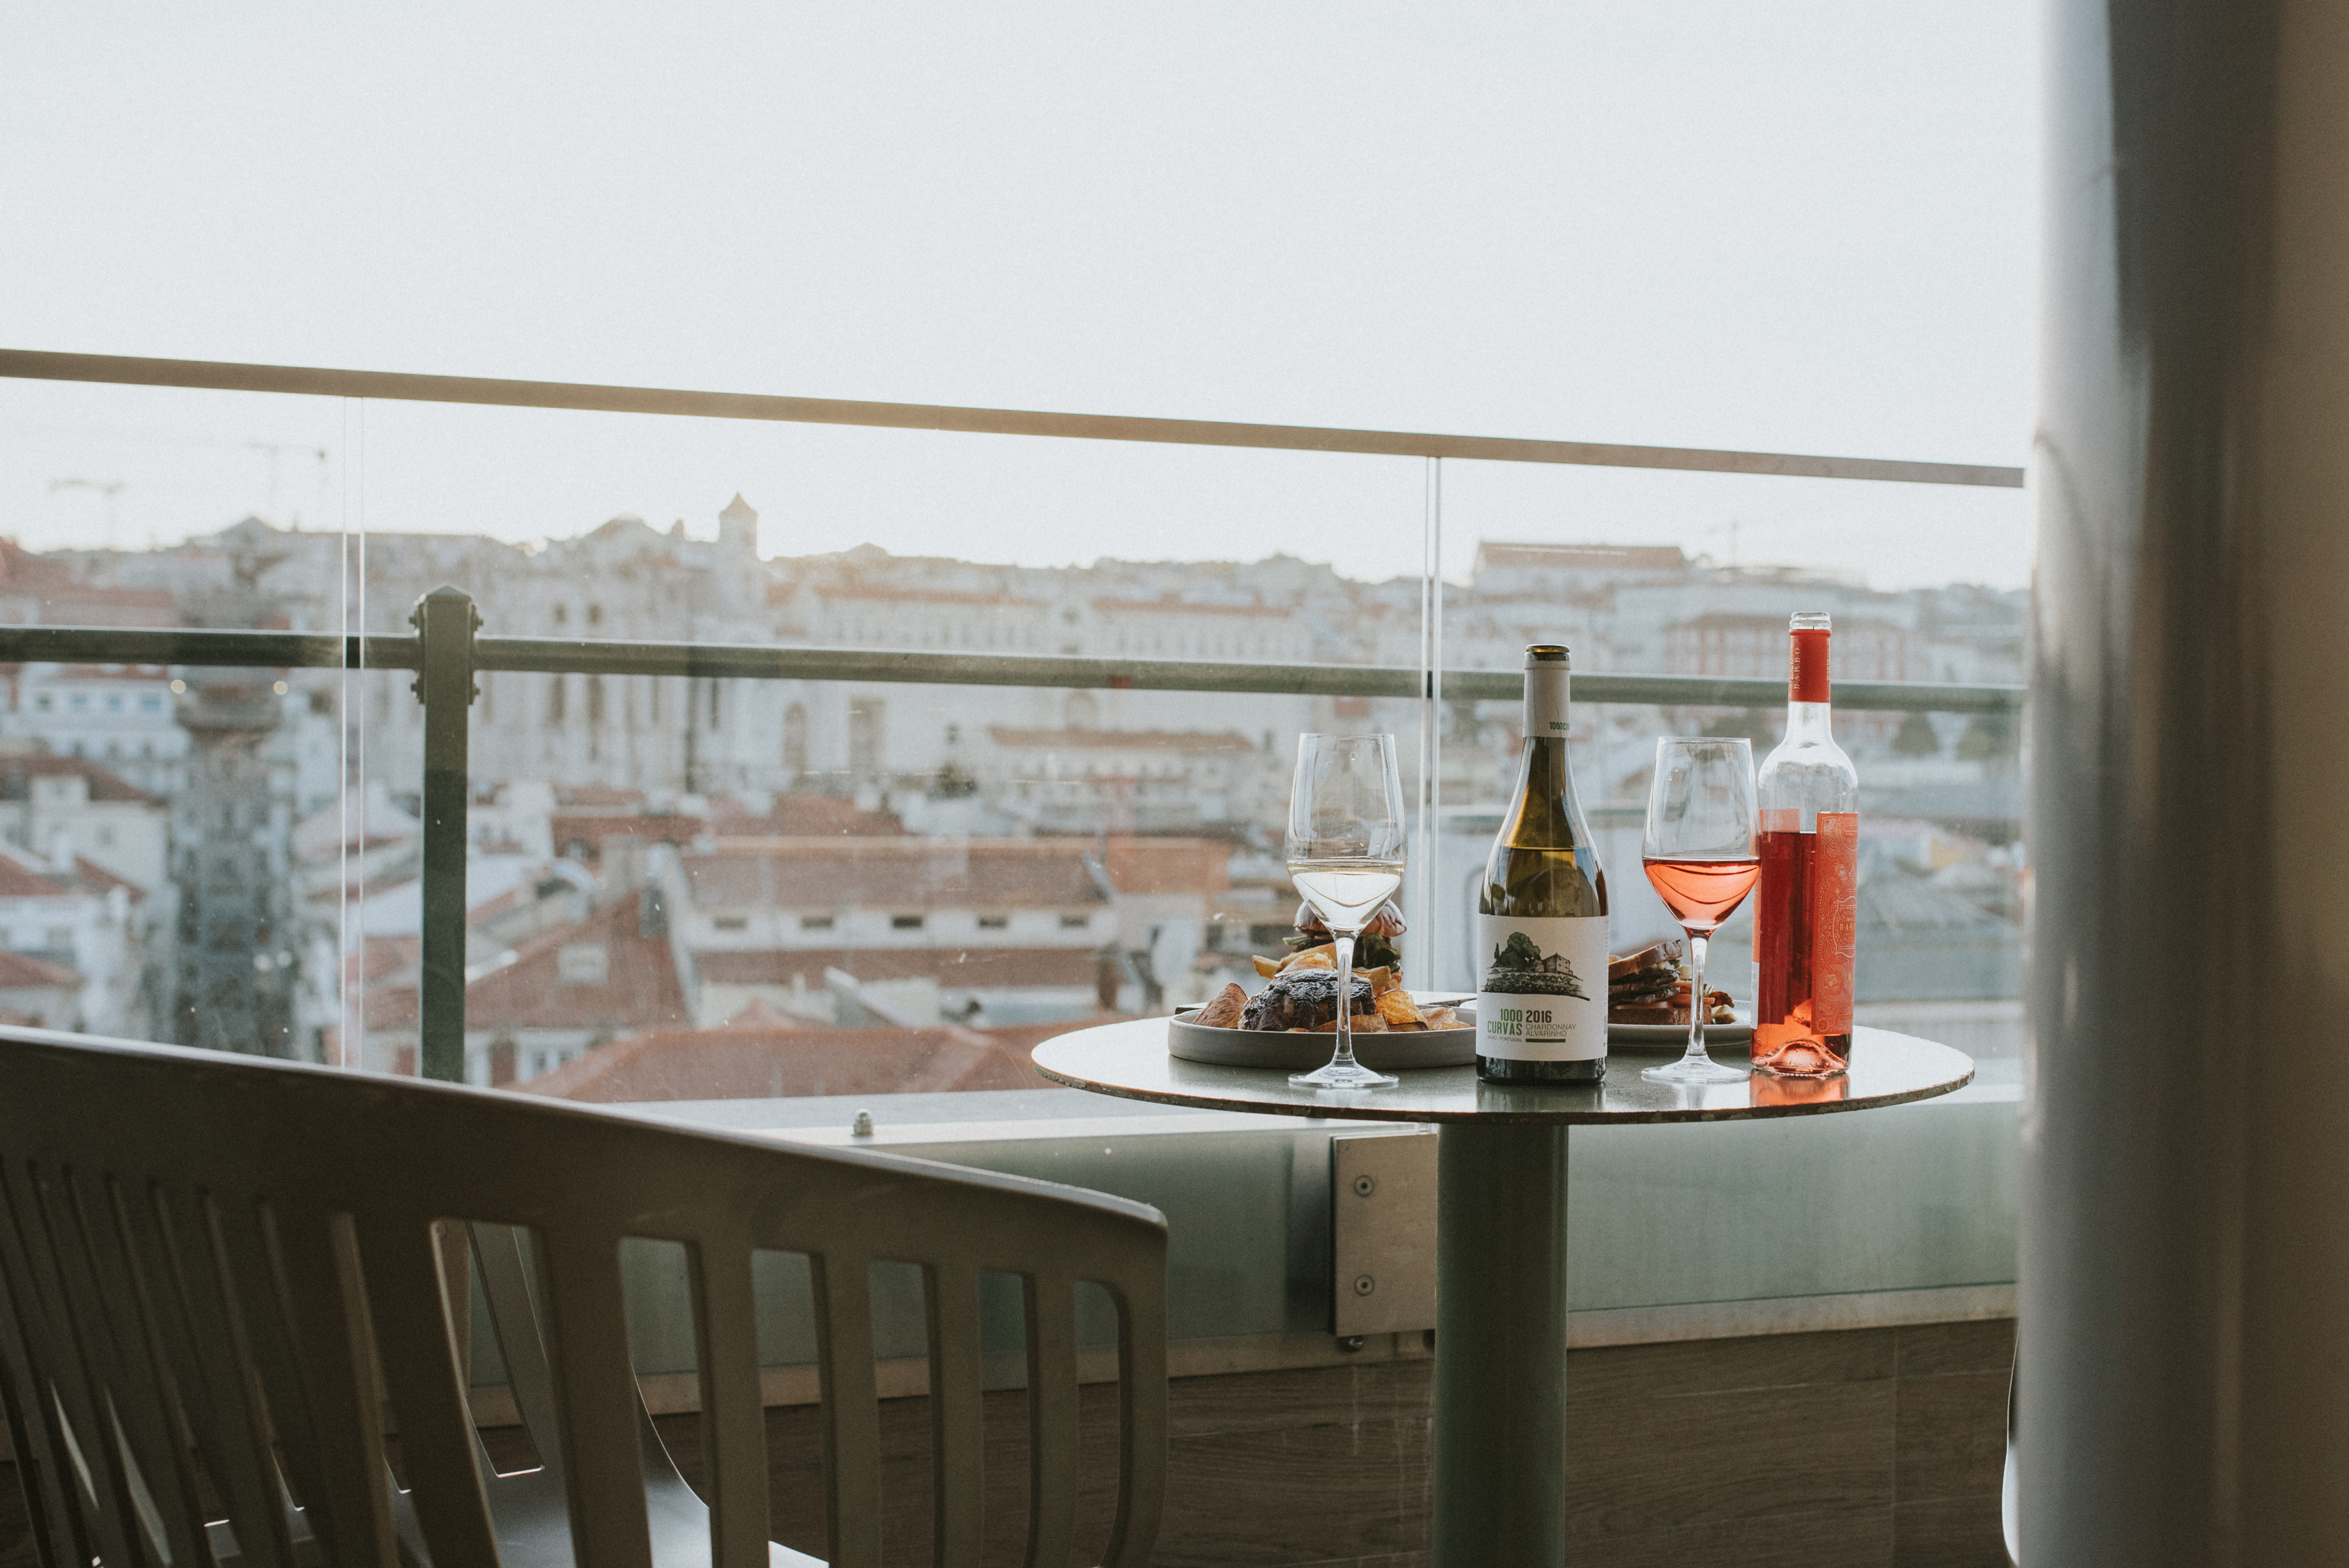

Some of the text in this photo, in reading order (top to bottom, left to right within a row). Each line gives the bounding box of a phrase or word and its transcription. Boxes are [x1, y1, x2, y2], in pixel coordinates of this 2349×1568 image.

[1500, 1008, 1523, 1022] 1000
[1526, 1010, 1552, 1023] 2016
[1488, 1021, 1522, 1036] CURVAS
